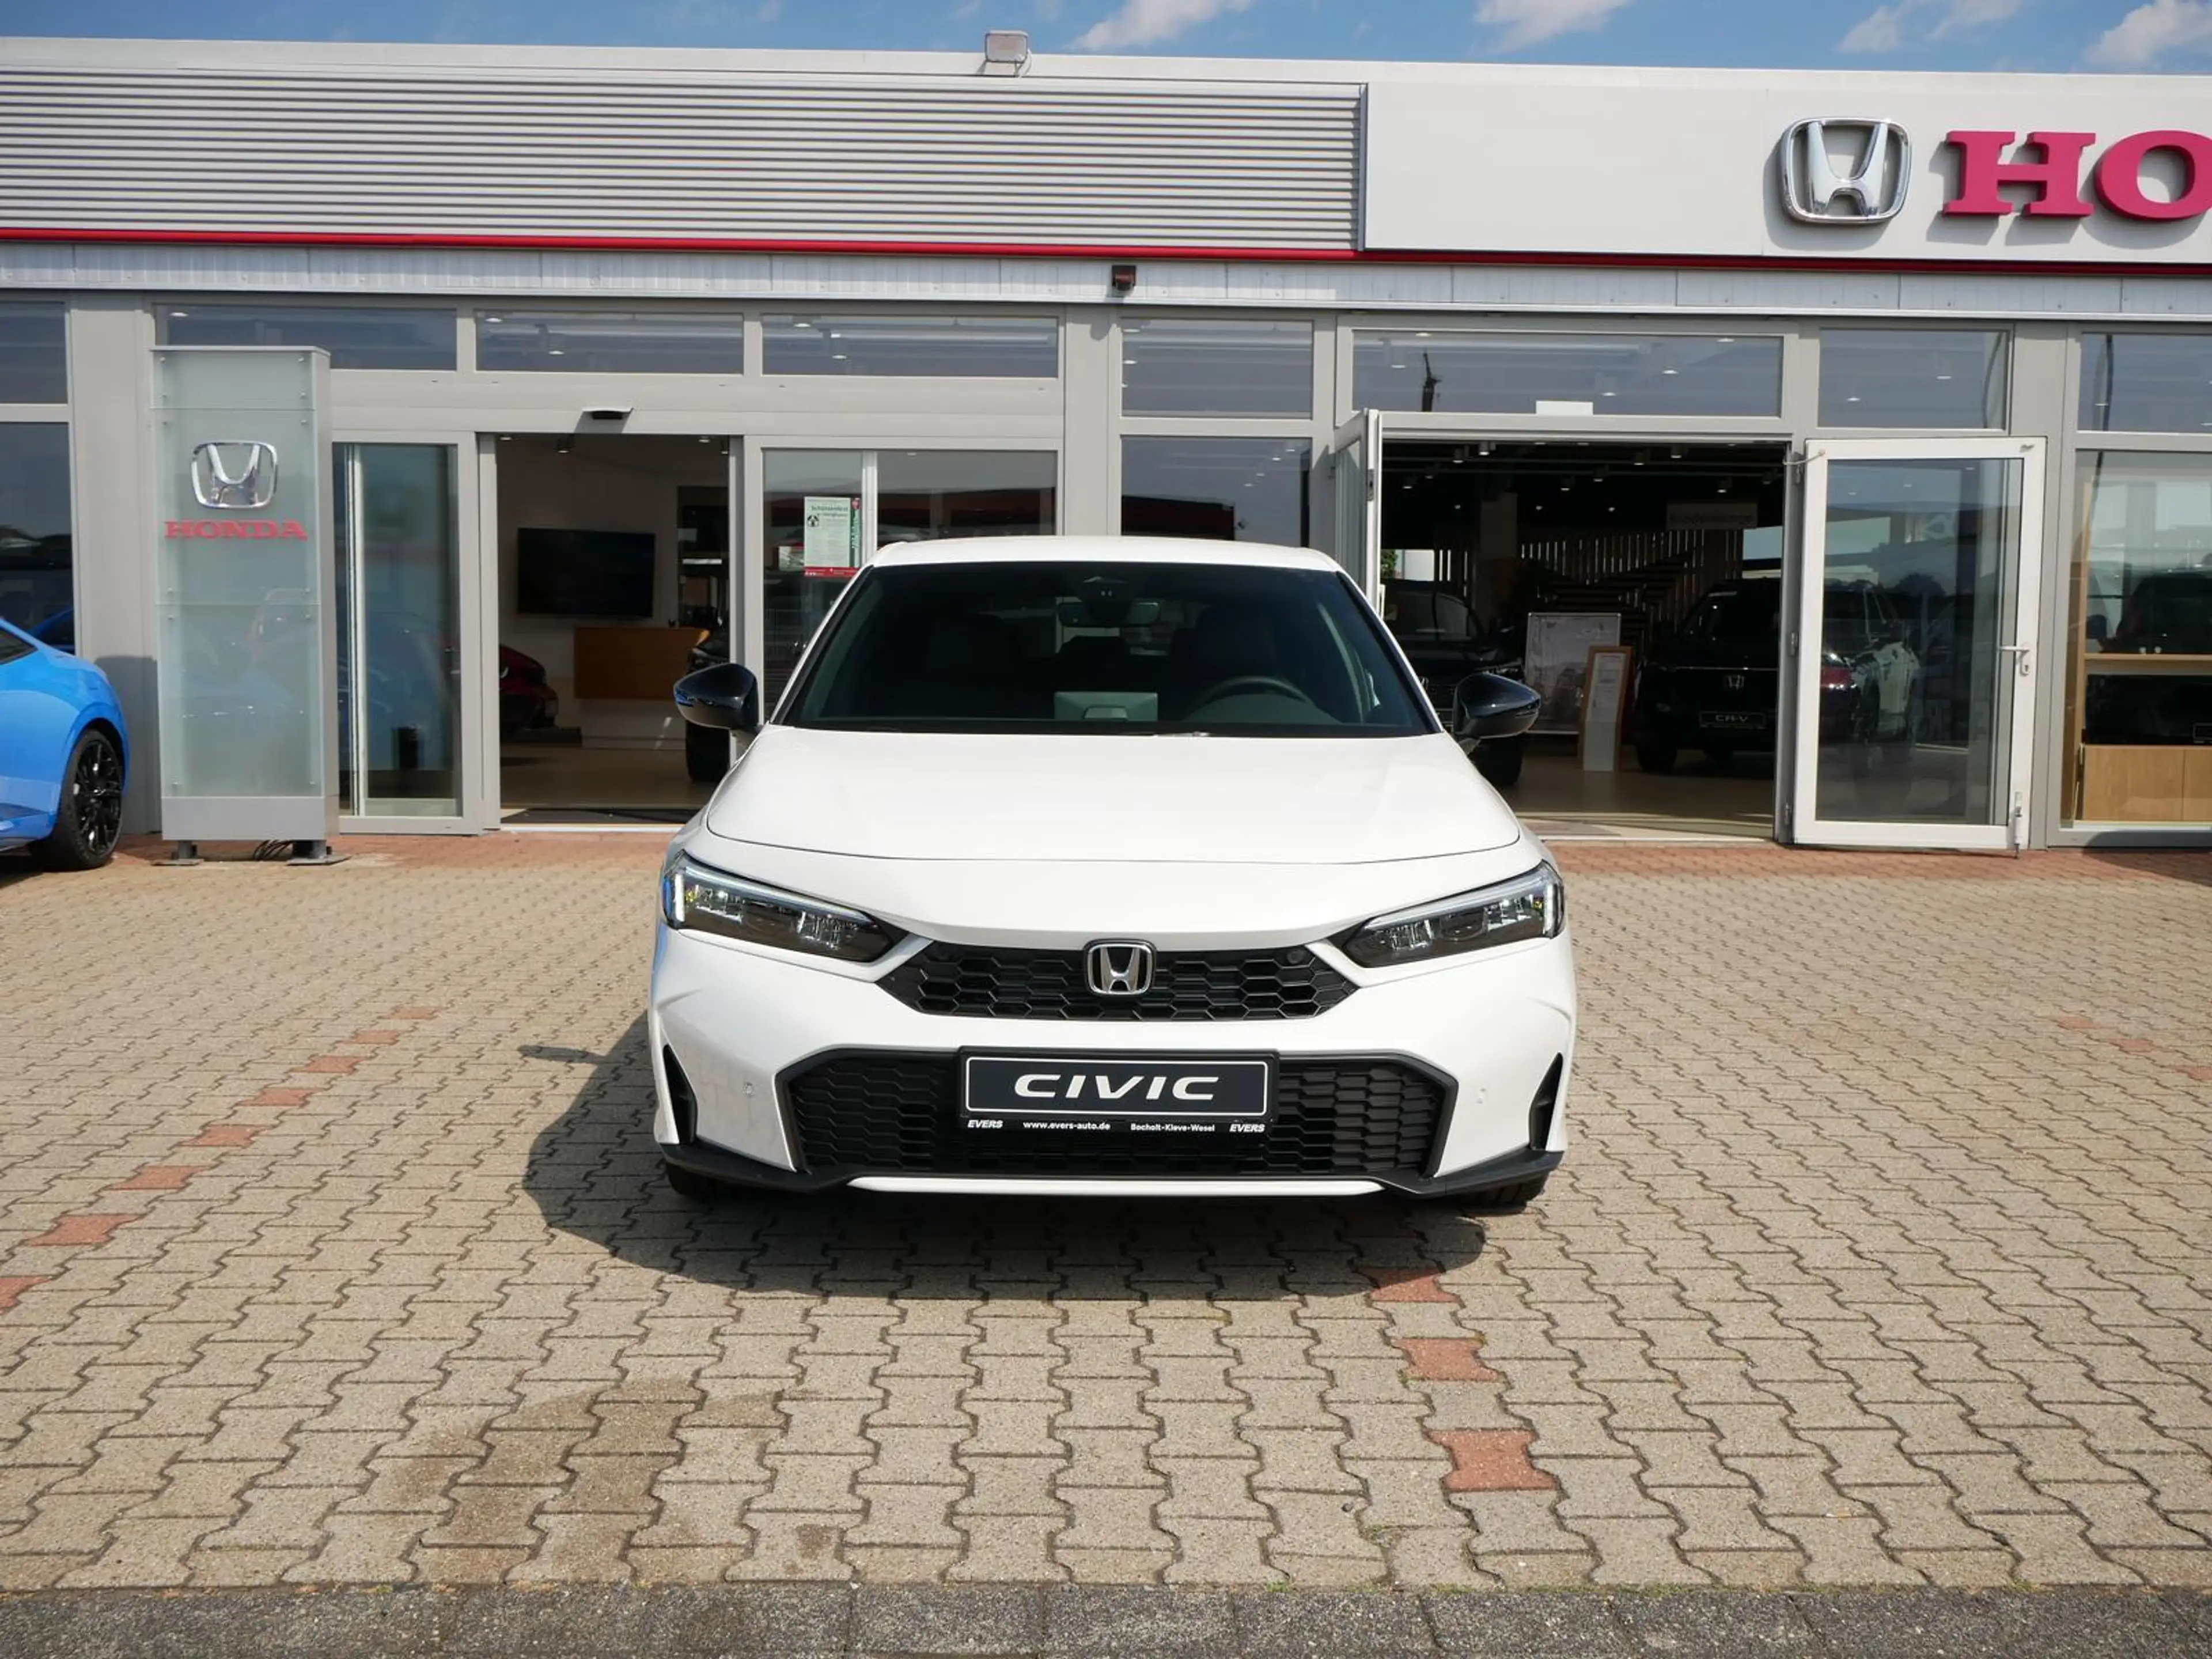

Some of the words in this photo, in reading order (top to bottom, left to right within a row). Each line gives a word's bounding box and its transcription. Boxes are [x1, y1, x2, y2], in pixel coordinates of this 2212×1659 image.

[164, 520, 308, 541] HONDA
[1014, 1073, 1219, 1100] CIVIC
[967, 1119, 1003, 1128] EVERS
[1022, 1121, 1111, 1131] www.evers-auto.de
[1229, 1124, 1266, 1132] EVERS
